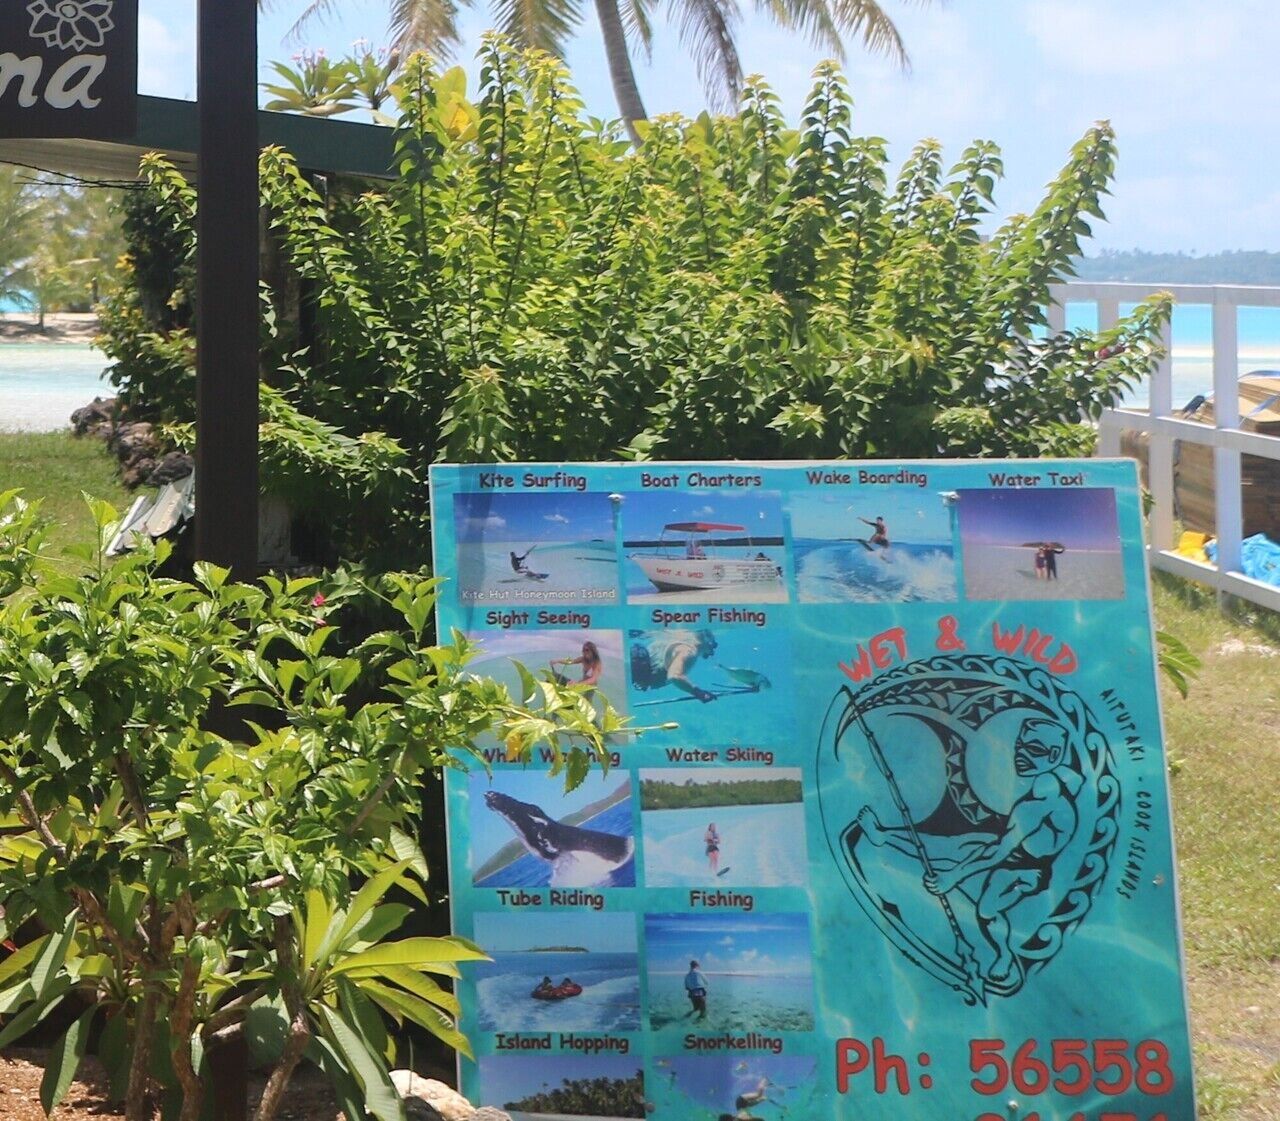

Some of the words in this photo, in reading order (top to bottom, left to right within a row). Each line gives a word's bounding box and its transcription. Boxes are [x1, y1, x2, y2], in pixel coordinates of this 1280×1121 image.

[479, 472, 515, 488] Kite
[524, 472, 587, 491] Surfing
[641, 473, 679, 487] Boat
[686, 472, 762, 487] Charters
[806, 471, 851, 485] Wake
[858, 470, 927, 487] Boarding
[988, 472, 1041, 486] Water
[1047, 472, 1084, 486] Taxi
[490, 590, 509, 599] Hut
[515, 590, 576, 601] Honeymoon
[581, 589, 616, 599] Island
[486, 610, 528, 628] Sight
[536, 610, 590, 629] Seeing
[652, 609, 700, 627] Spear
[708, 608, 766, 627] Fishing
[838, 626, 907, 682] WET
[936, 615, 965, 651] &
[993, 621, 1077, 674] WILD
[1100, 688, 1145, 762] AITUTAKI
[666, 747, 718, 763] Water
[725, 747, 774, 765] Skiing
[1134, 791, 1152, 832] COOK
[1116, 836, 1146, 900] ISLANDS
[497, 890, 542, 906] Tube
[549, 890, 604, 909] Riding
[689, 890, 754, 911] Fishing
[495, 1033, 552, 1050] Island
[560, 1033, 629, 1054] Hopping
[683, 1033, 783, 1054] Snorkelling
[835, 1036, 933, 1096] Ph:
[969, 1038, 1175, 1097] 56558
